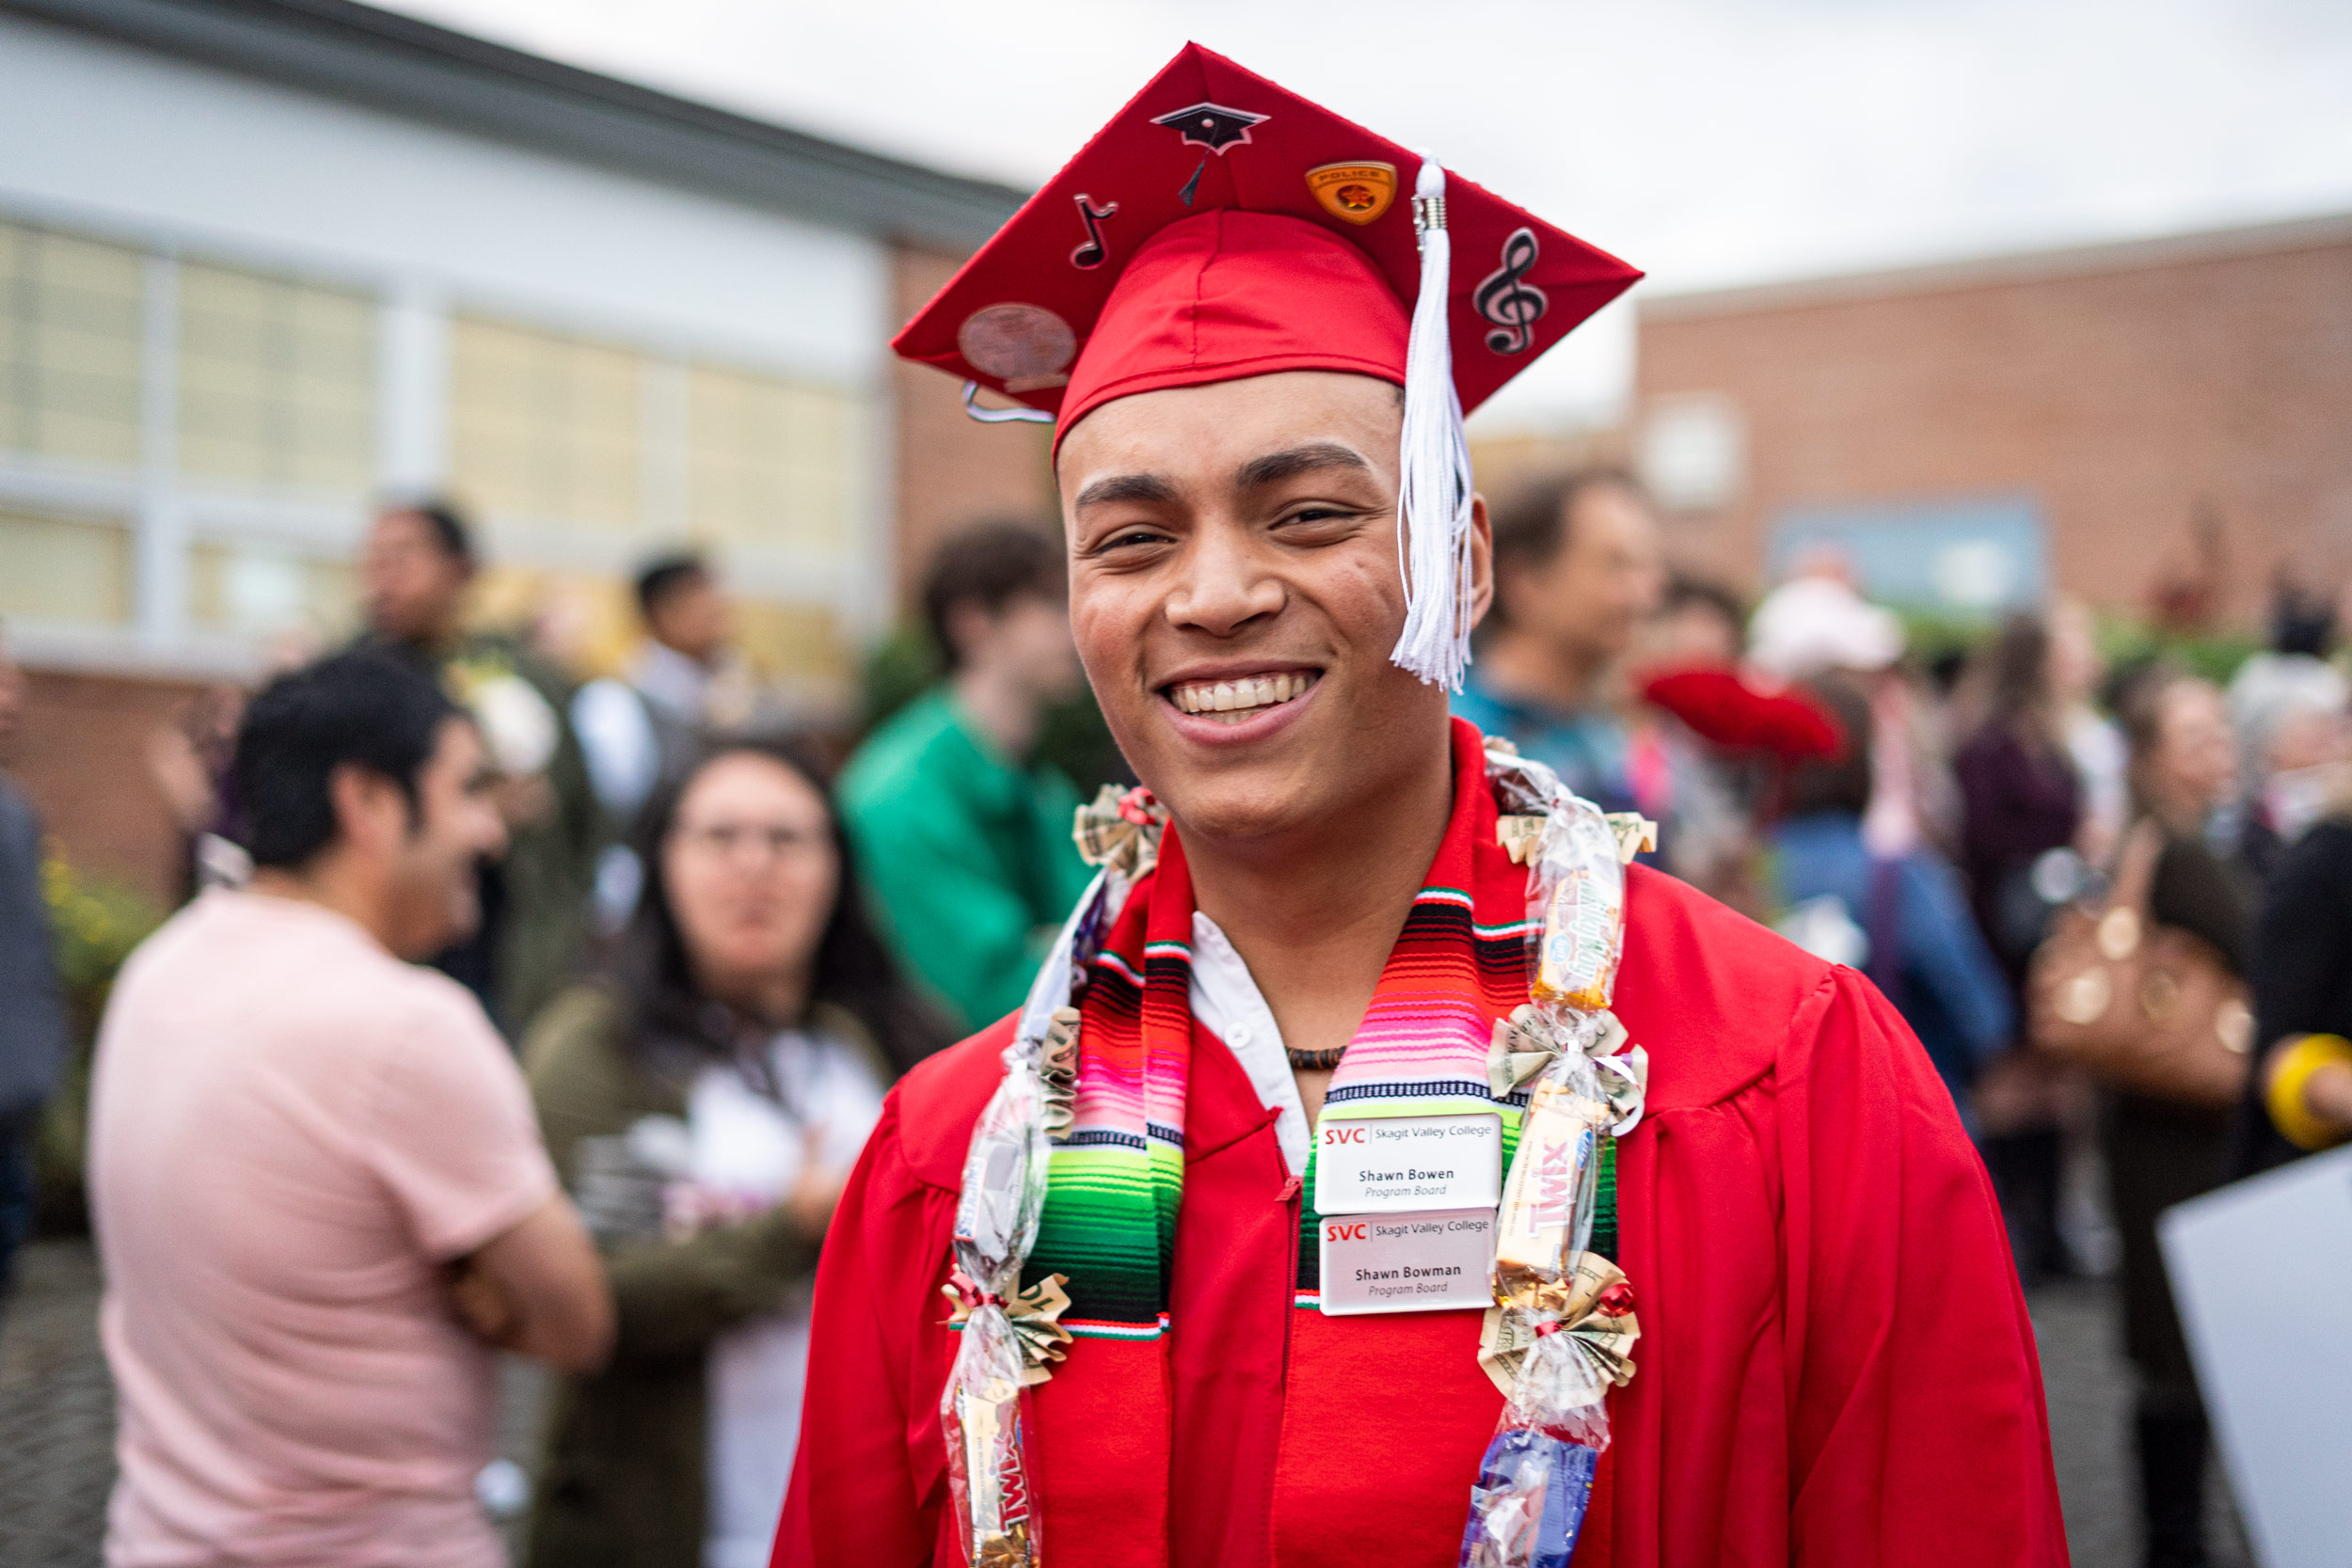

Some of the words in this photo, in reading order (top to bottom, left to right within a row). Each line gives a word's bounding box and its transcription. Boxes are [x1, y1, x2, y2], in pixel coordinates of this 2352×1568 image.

[1318, 170, 1379, 181] POLICE
[1325, 1128, 1365, 1145] SVC
[1375, 1127, 1408, 1140] Skagit
[1411, 1127, 1445, 1138] Valley
[1449, 1125, 1491, 1136] College
[1359, 1170, 1403, 1181] Shawn
[1408, 1169, 1454, 1180] Bowen
[1365, 1186, 1411, 1199] Program
[1414, 1185, 1447, 1196] Board
[1327, 1224, 1366, 1242] SVC
[1375, 1225, 1408, 1238] Skagit
[1411, 1223, 1444, 1235] Valley
[1447, 1220, 1488, 1231] College
[1356, 1269, 1399, 1281] Shawn
[1404, 1266, 1461, 1278] Bowman
[1368, 1285, 1413, 1298] Program
[1417, 1281, 1448, 1293] Board
